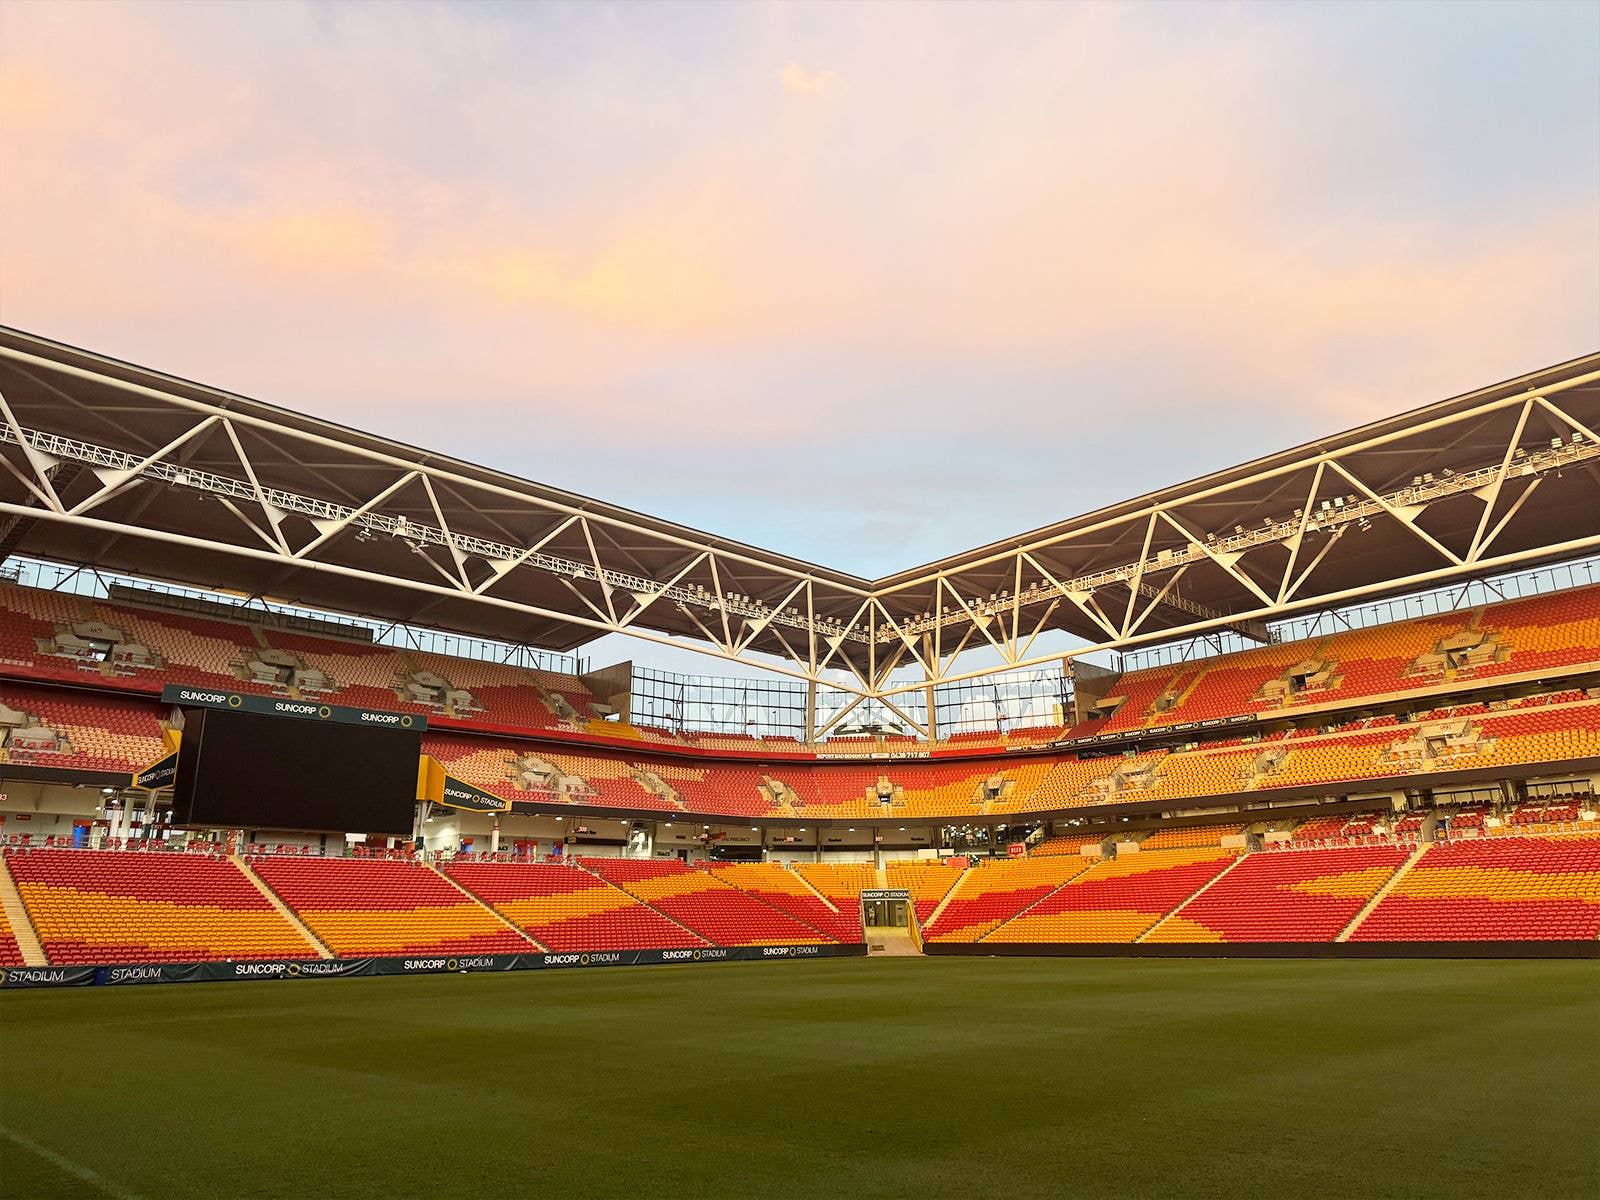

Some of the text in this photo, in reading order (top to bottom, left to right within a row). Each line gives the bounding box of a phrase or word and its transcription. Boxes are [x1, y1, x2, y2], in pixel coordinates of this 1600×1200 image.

[180, 690, 226, 703] SUNCORP
[275, 702, 317, 714] SUNCORP
[361, 712, 399, 724] SUNCORP
[444, 788, 505, 808] SUNCORP STADIUM
[662, 949, 727, 960] SUNCORP STADIUM
[763, 946, 818, 956] SUNCORP STADIUM
[404, 958, 494, 970] SUNCORP STADIUM
[544, 953, 620, 965] SUNCORP STADIUM
[111, 968, 162, 980] STADIUM
[235, 963, 344, 975] SUNCORP STADIUM
[9, 970, 65, 982] STADIUM
